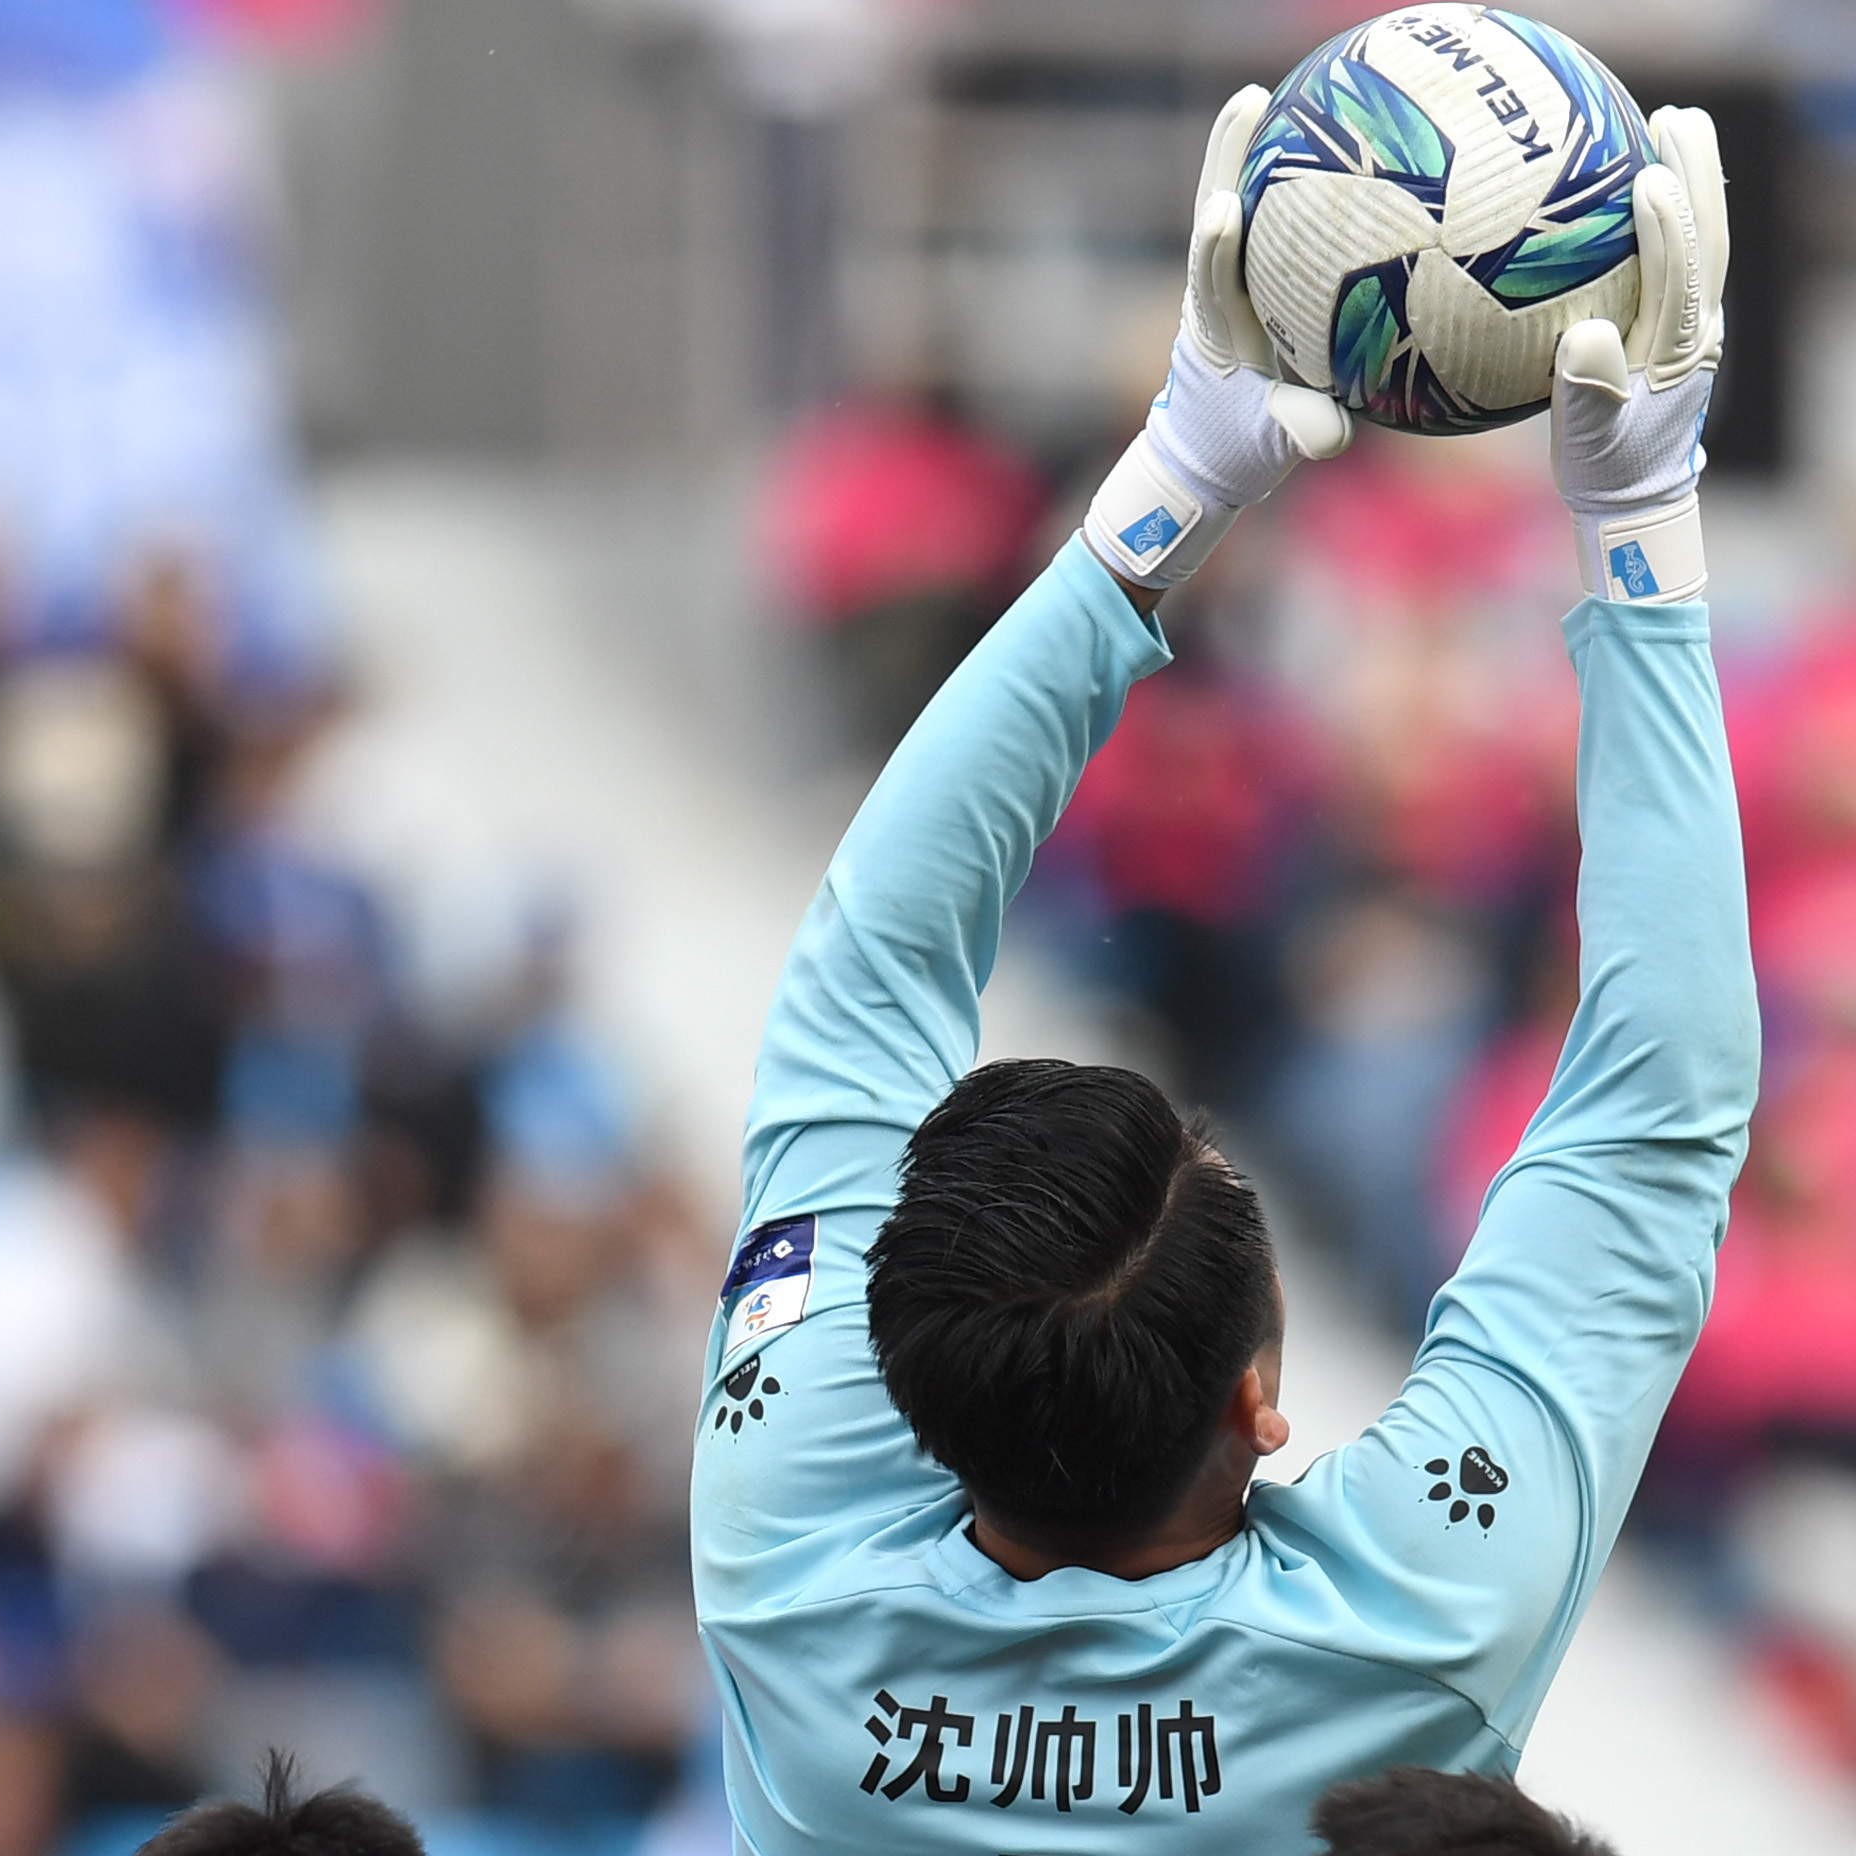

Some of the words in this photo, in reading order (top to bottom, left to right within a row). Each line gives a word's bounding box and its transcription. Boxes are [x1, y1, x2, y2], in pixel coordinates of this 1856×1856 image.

[1409, 24, 1553, 164] KELME
[1466, 1449, 1504, 1488] KELME
[859, 1688, 1221, 1815] 沈帅帅
